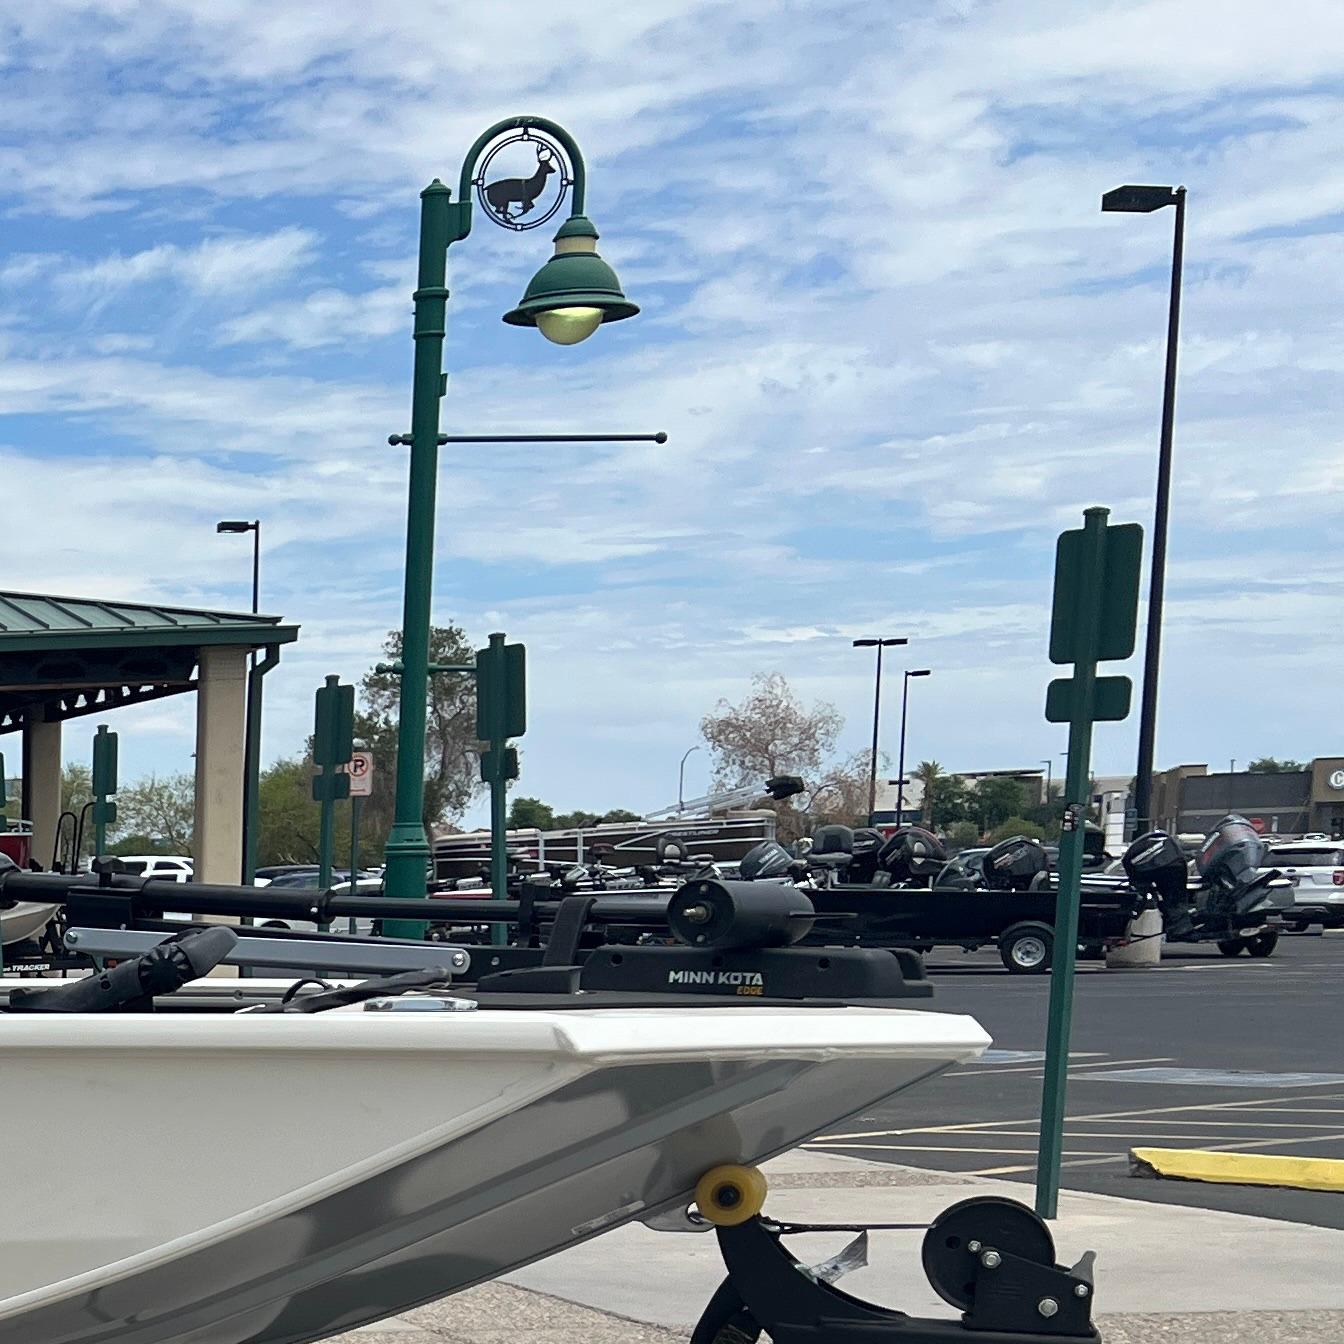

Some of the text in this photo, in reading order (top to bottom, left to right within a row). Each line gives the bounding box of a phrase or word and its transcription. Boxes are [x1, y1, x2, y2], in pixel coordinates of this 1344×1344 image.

[668, 970, 764, 985] MINN KOTA
[736, 985, 764, 995] EDGE
